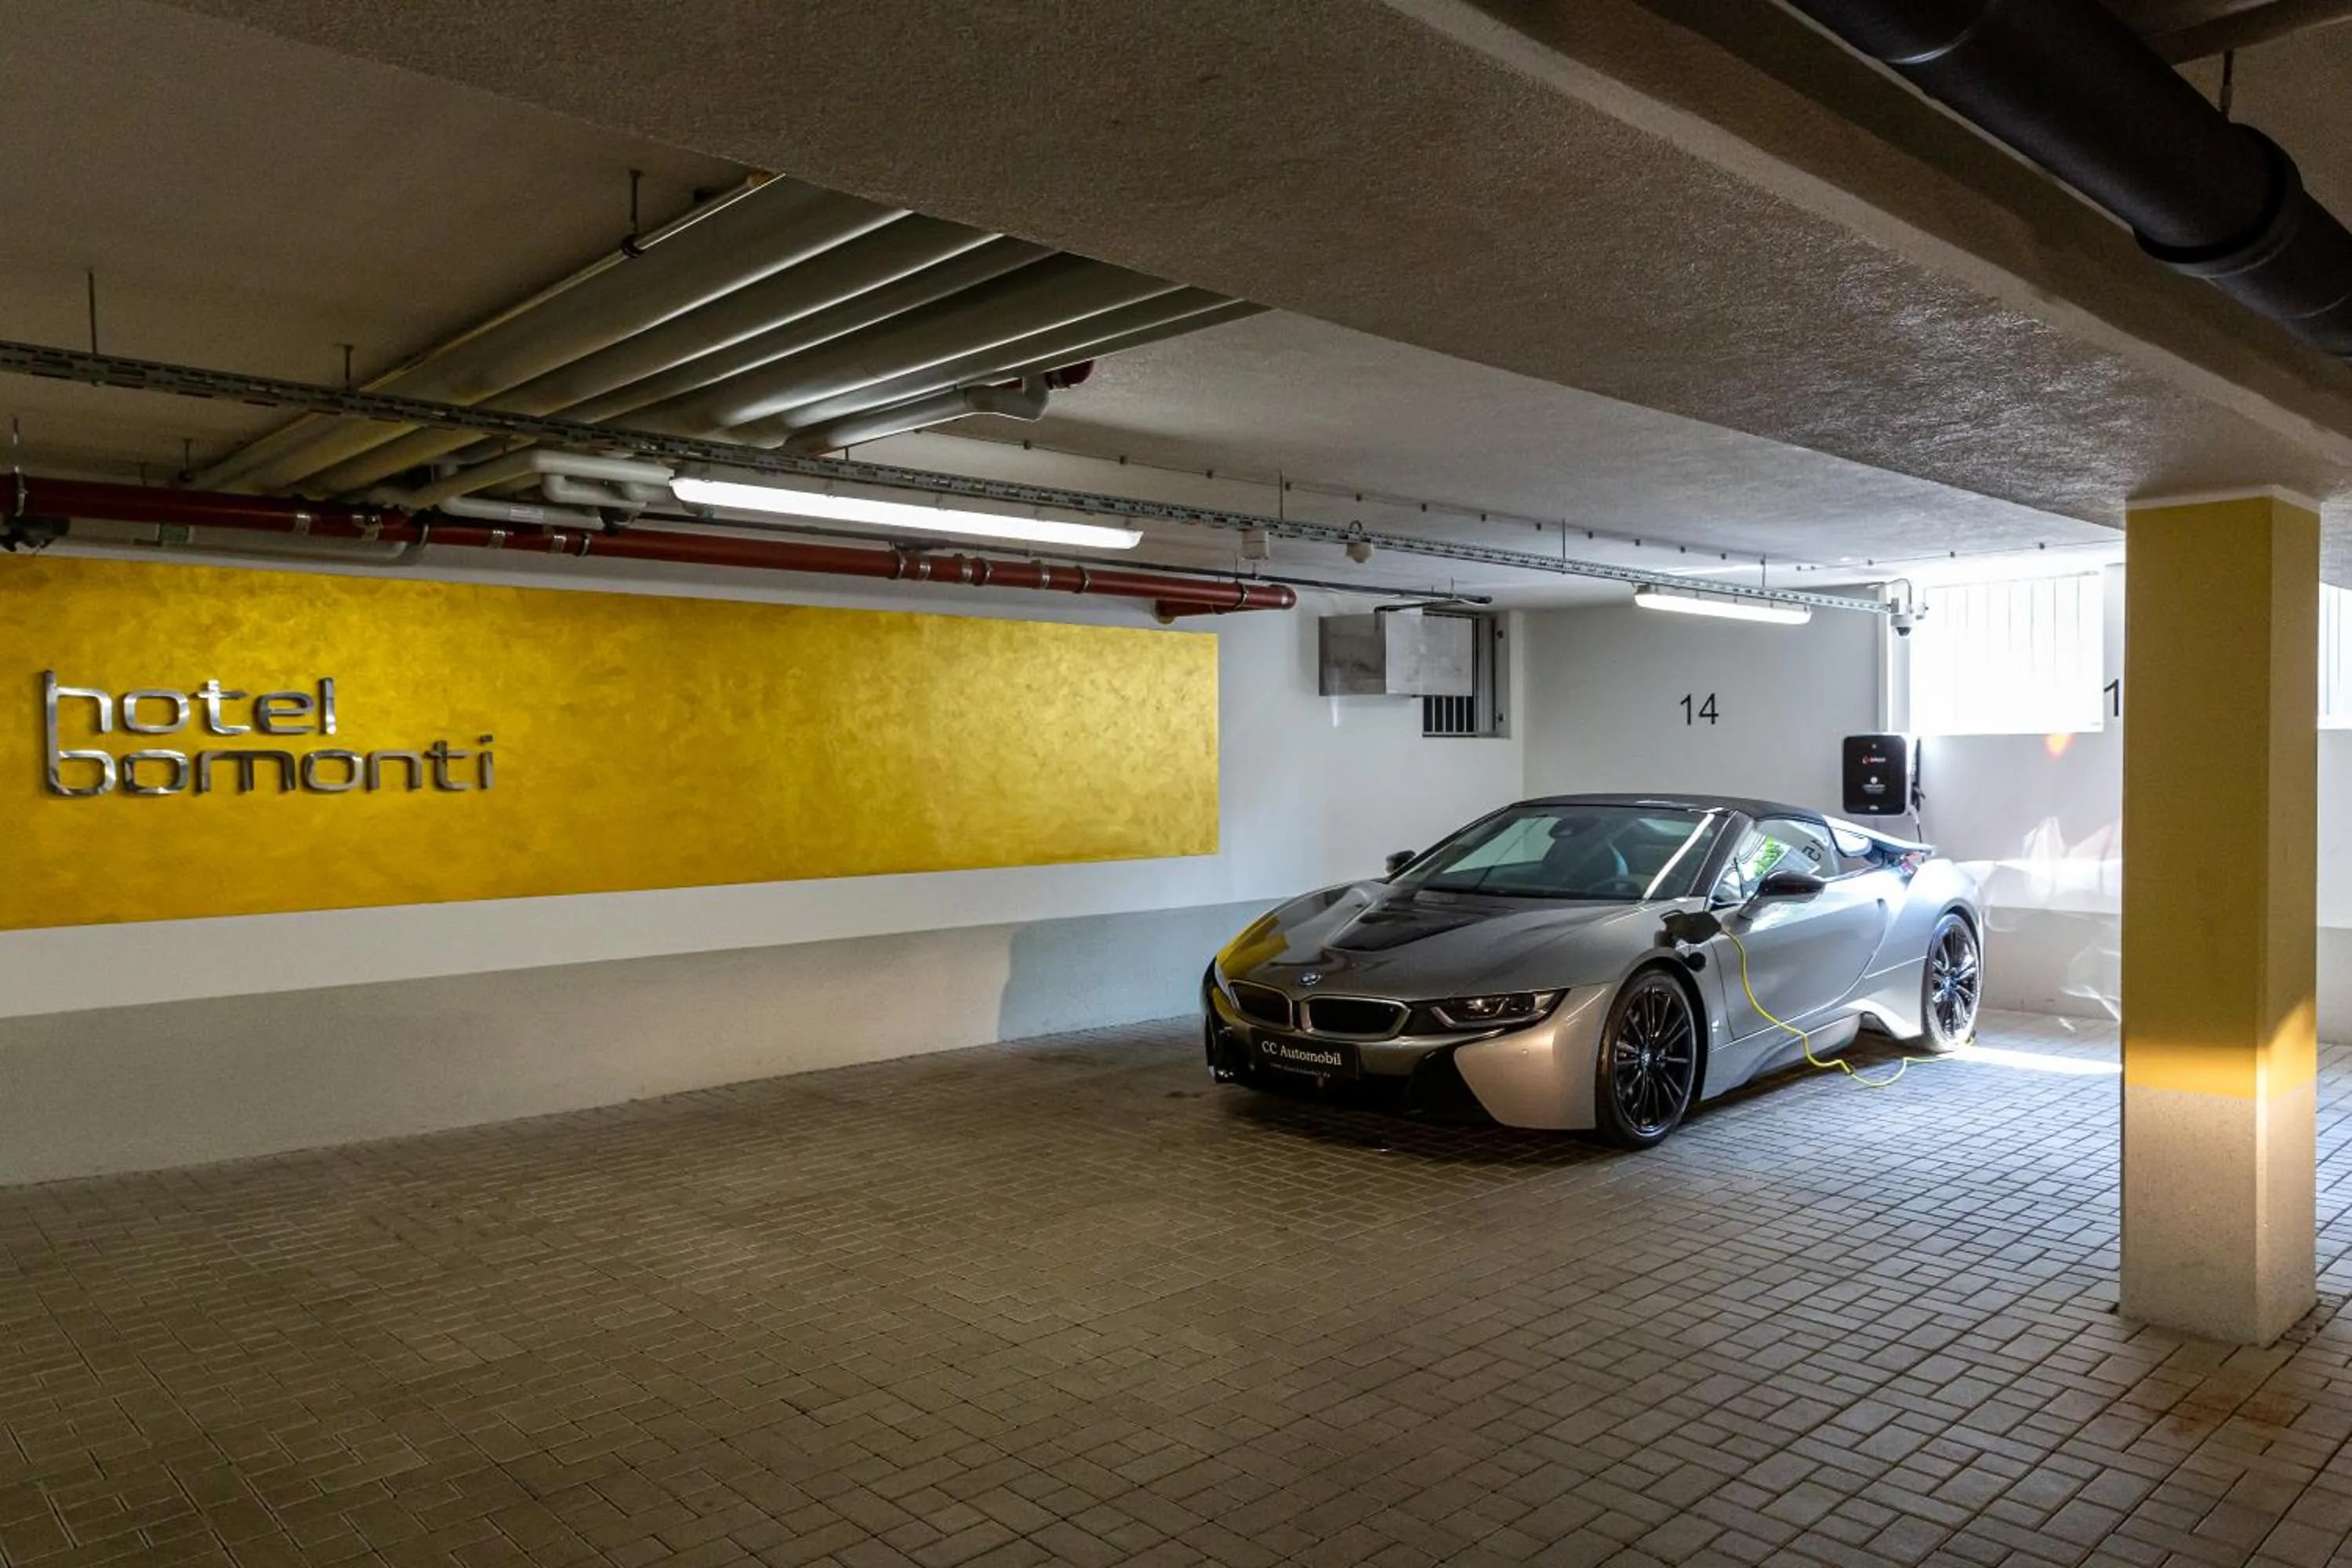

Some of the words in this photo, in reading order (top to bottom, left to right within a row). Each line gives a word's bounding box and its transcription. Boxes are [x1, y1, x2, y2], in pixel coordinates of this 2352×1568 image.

[45, 670, 336, 735] hotel
[1680, 692, 1719, 725] 14
[2103, 678, 2119, 717] 1
[45, 734, 494, 797] bomonti
[1261, 1040, 1277, 1054] CC
[1279, 1044, 1342, 1065] Automobil
